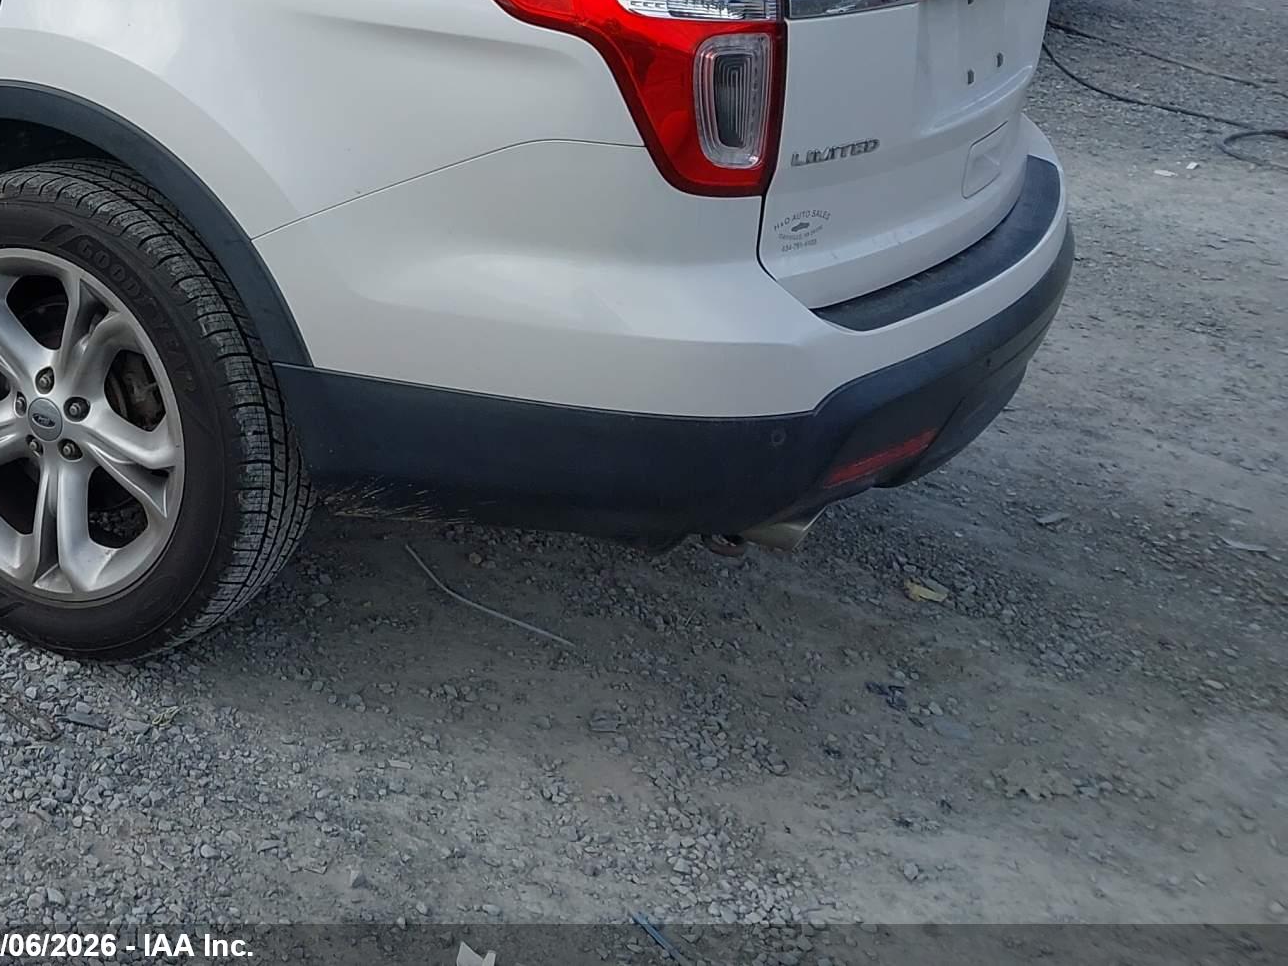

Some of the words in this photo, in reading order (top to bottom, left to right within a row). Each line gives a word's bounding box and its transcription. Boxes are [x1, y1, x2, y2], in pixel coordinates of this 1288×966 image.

[791, 138, 880, 167] LIMITED
[792, 209, 811, 221] AUTO
[811, 209, 831, 221] SALES
